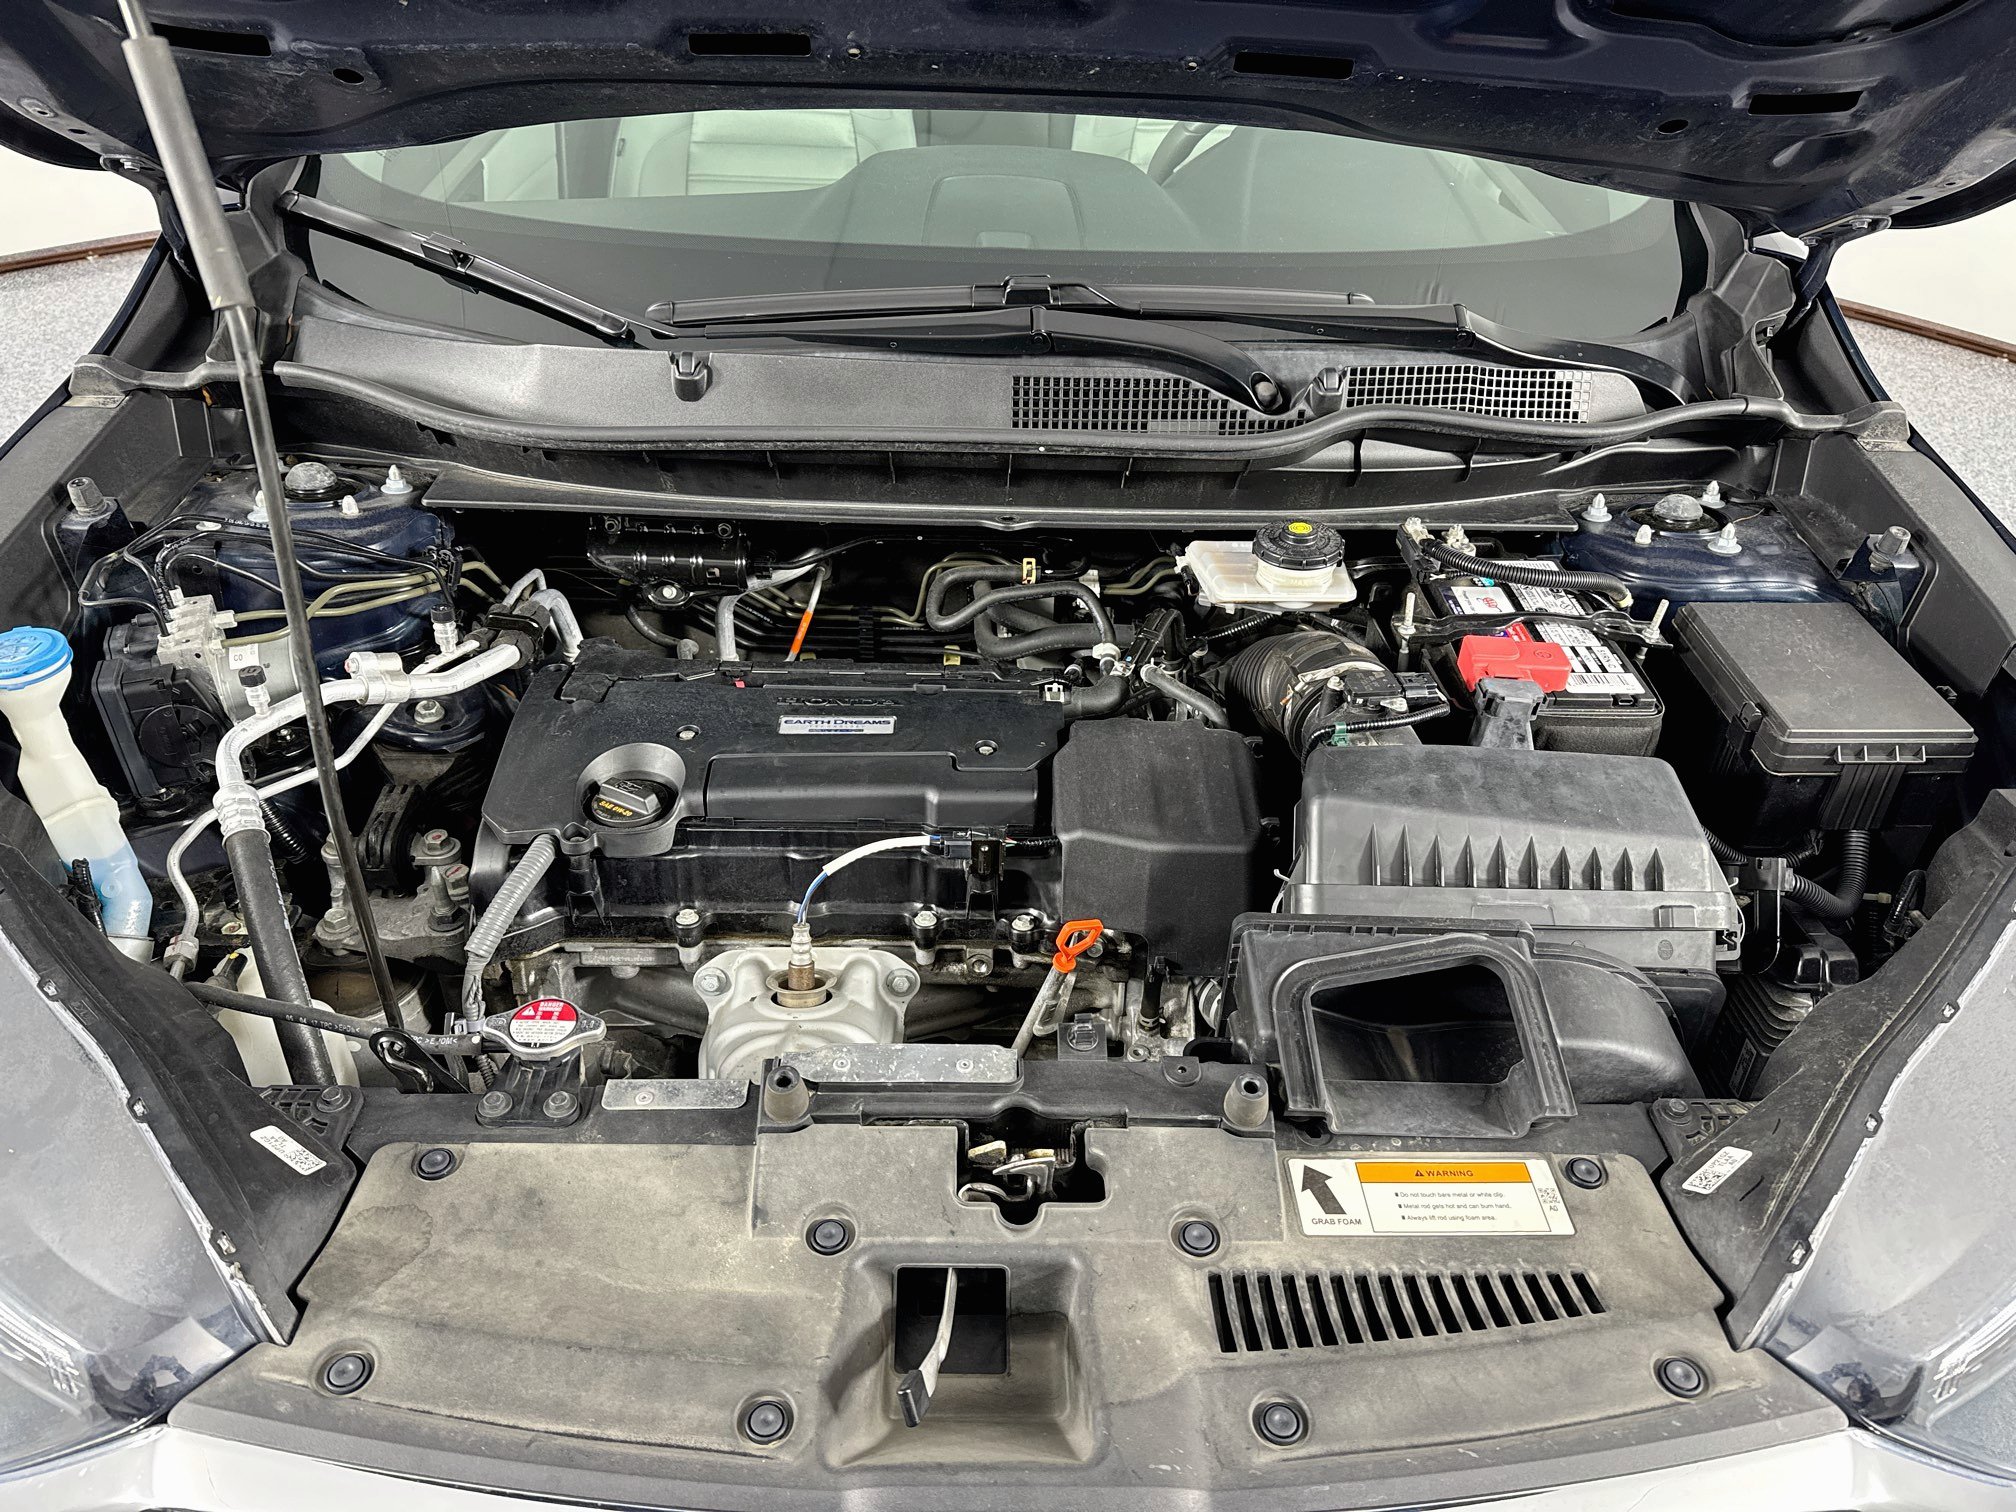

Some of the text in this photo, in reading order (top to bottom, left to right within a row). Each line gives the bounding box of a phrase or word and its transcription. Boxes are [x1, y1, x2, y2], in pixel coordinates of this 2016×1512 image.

[598, 800, 615, 810] SAE
[612, 806, 633, 817] 0W-20
[1432, 1203, 1445, 1211] gets
[1311, 1217, 1362, 1226] GRAB FOAM
